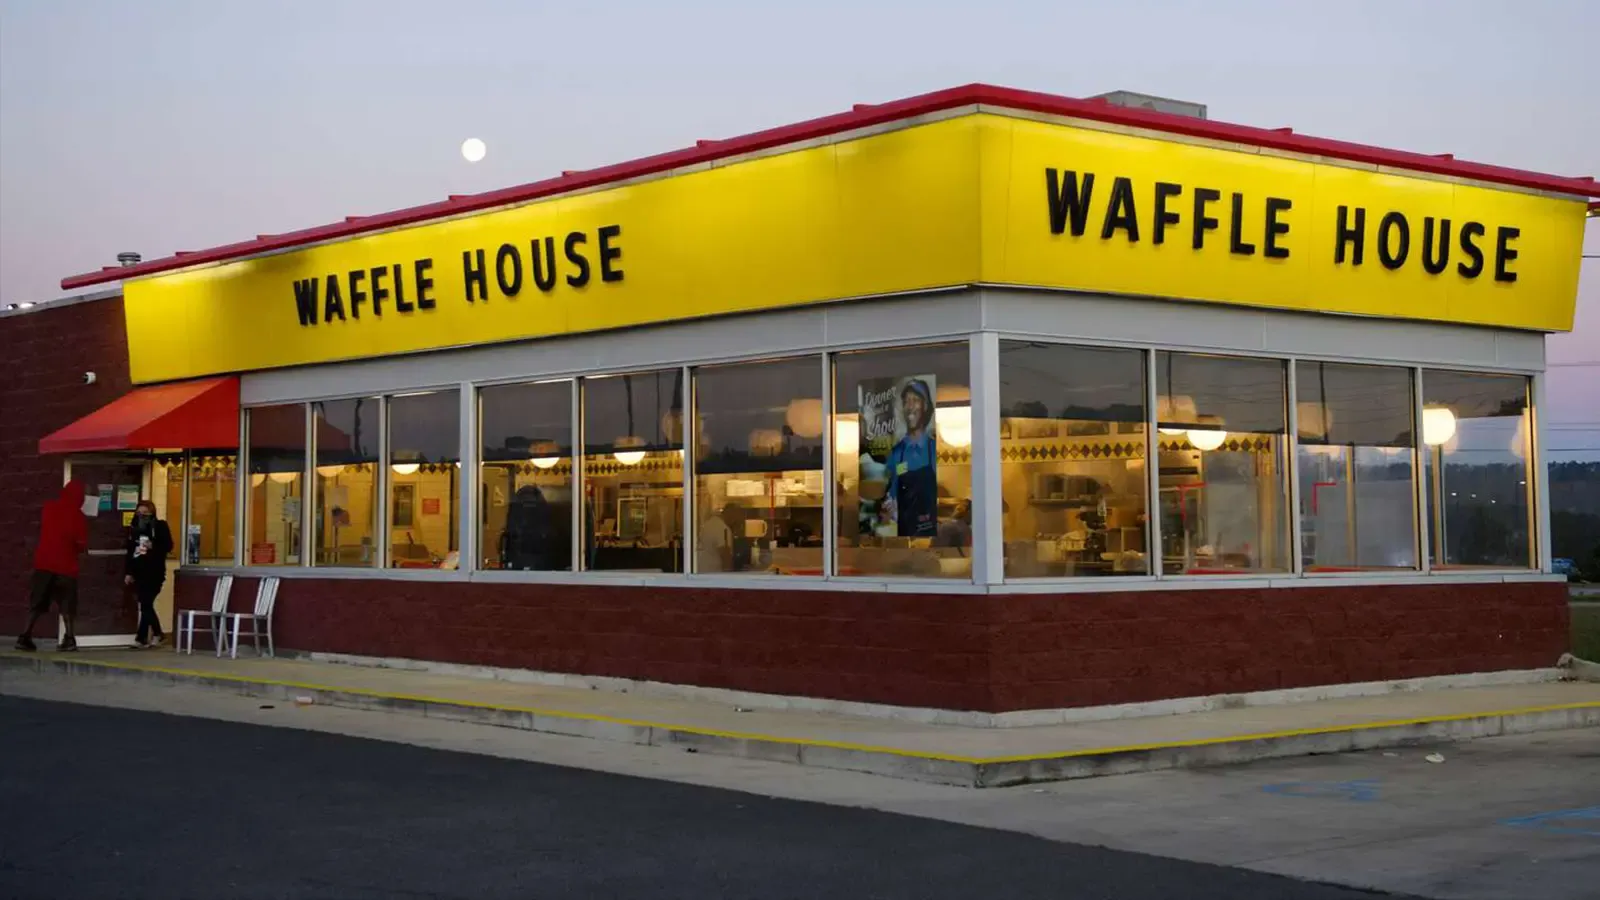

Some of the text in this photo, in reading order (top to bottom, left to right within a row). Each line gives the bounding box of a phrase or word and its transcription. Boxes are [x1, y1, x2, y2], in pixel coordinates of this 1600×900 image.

[293, 225, 623, 327] WAFFLE HOUSE
[1046, 168, 1521, 283] WAFFLE HOUSE
